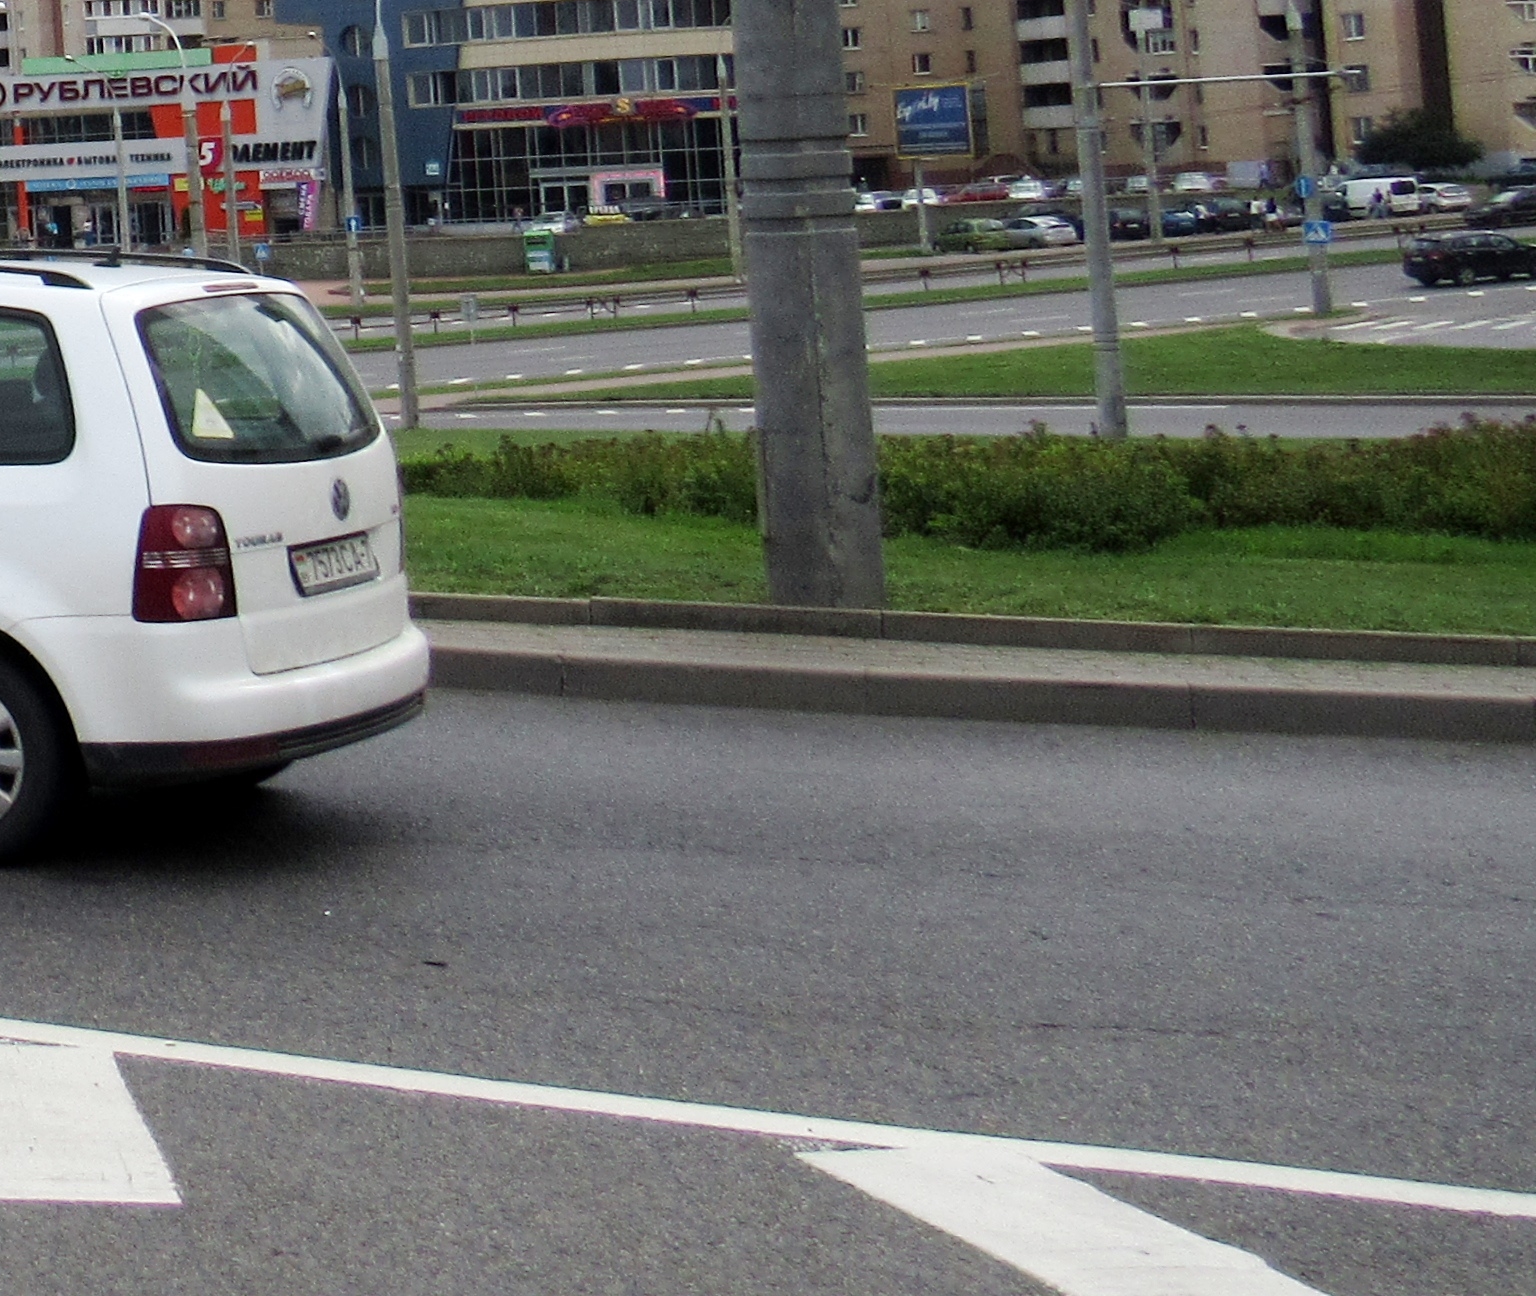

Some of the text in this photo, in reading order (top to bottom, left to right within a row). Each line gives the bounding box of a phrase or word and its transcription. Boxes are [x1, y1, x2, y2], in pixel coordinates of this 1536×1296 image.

[13, 65, 258, 103] РУБЛЕВСКИЙ
[77, 155, 117, 166] БЫТОВА
[130, 152, 171, 162] ТЕХНИКА
[198, 141, 216, 166] 5
